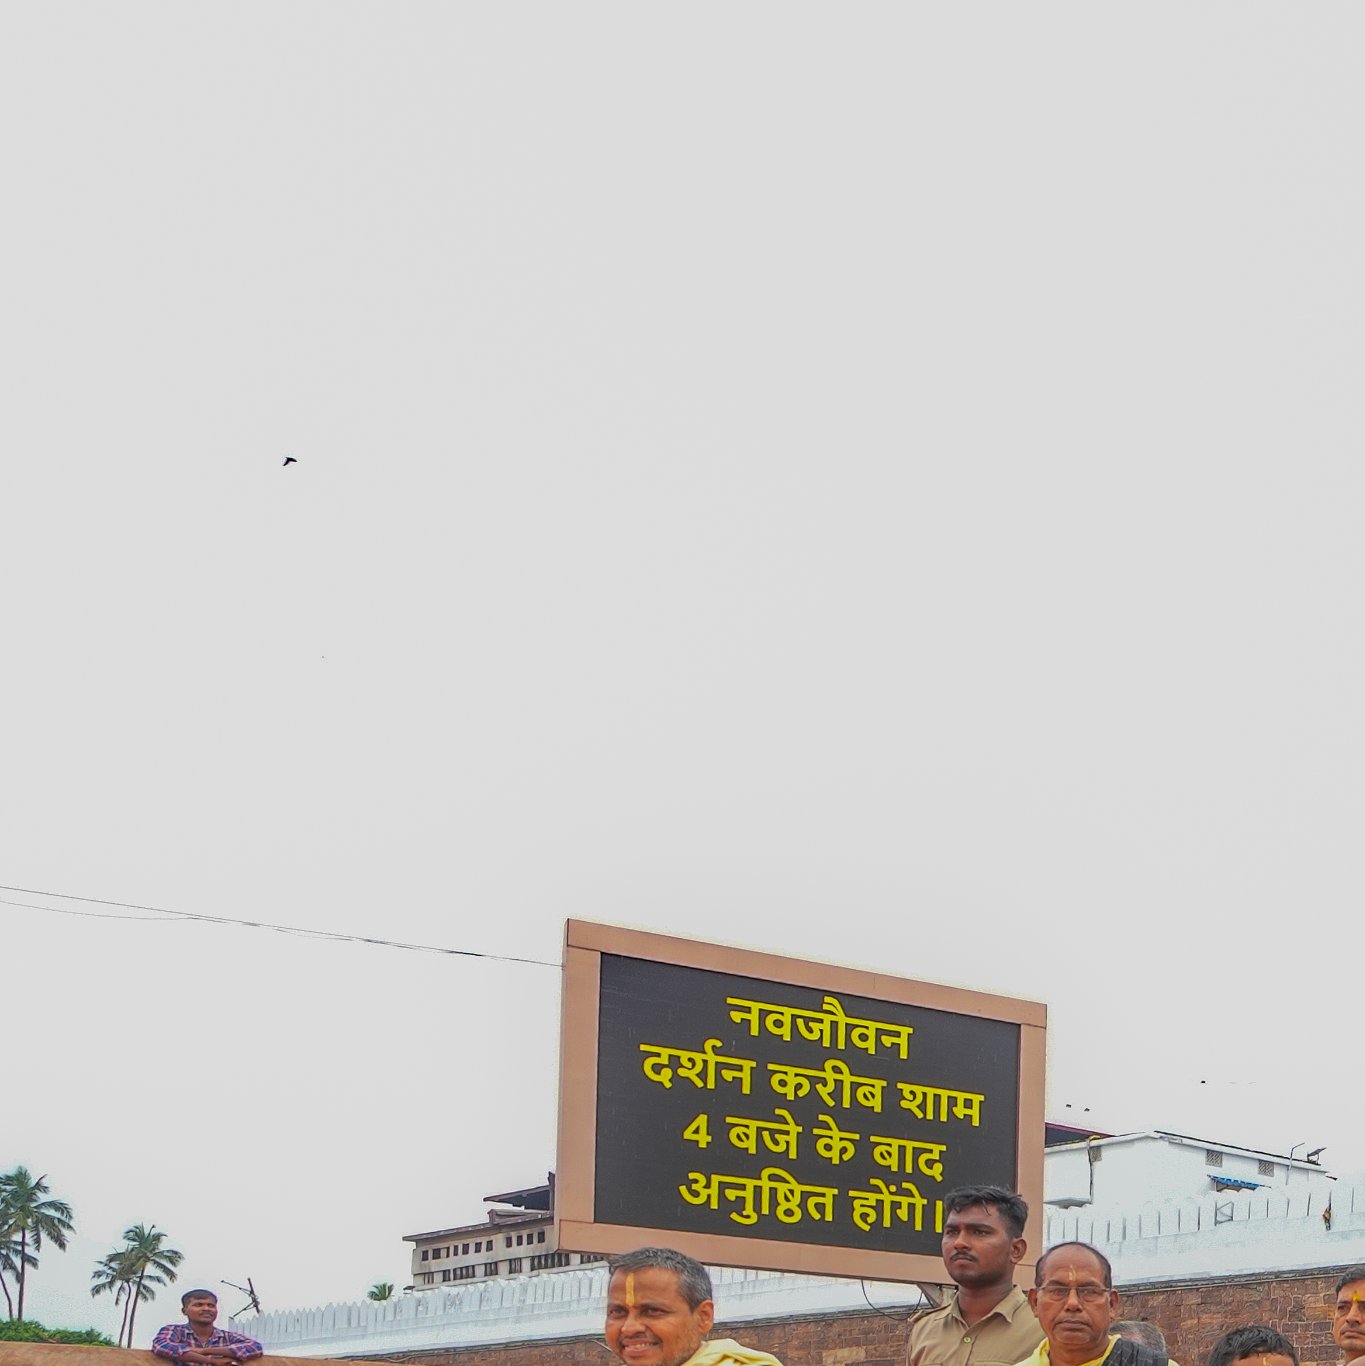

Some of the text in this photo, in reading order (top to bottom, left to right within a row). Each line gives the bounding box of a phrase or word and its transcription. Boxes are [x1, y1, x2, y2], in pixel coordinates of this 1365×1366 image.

[726, 996, 912, 1059] नवजौवन
[640, 1039, 984, 1126] दर्शन करीब शाम
[683, 1108, 946, 1182] 4 बजे के बाद
[679, 1167, 838, 1224] अनुष्ठित
